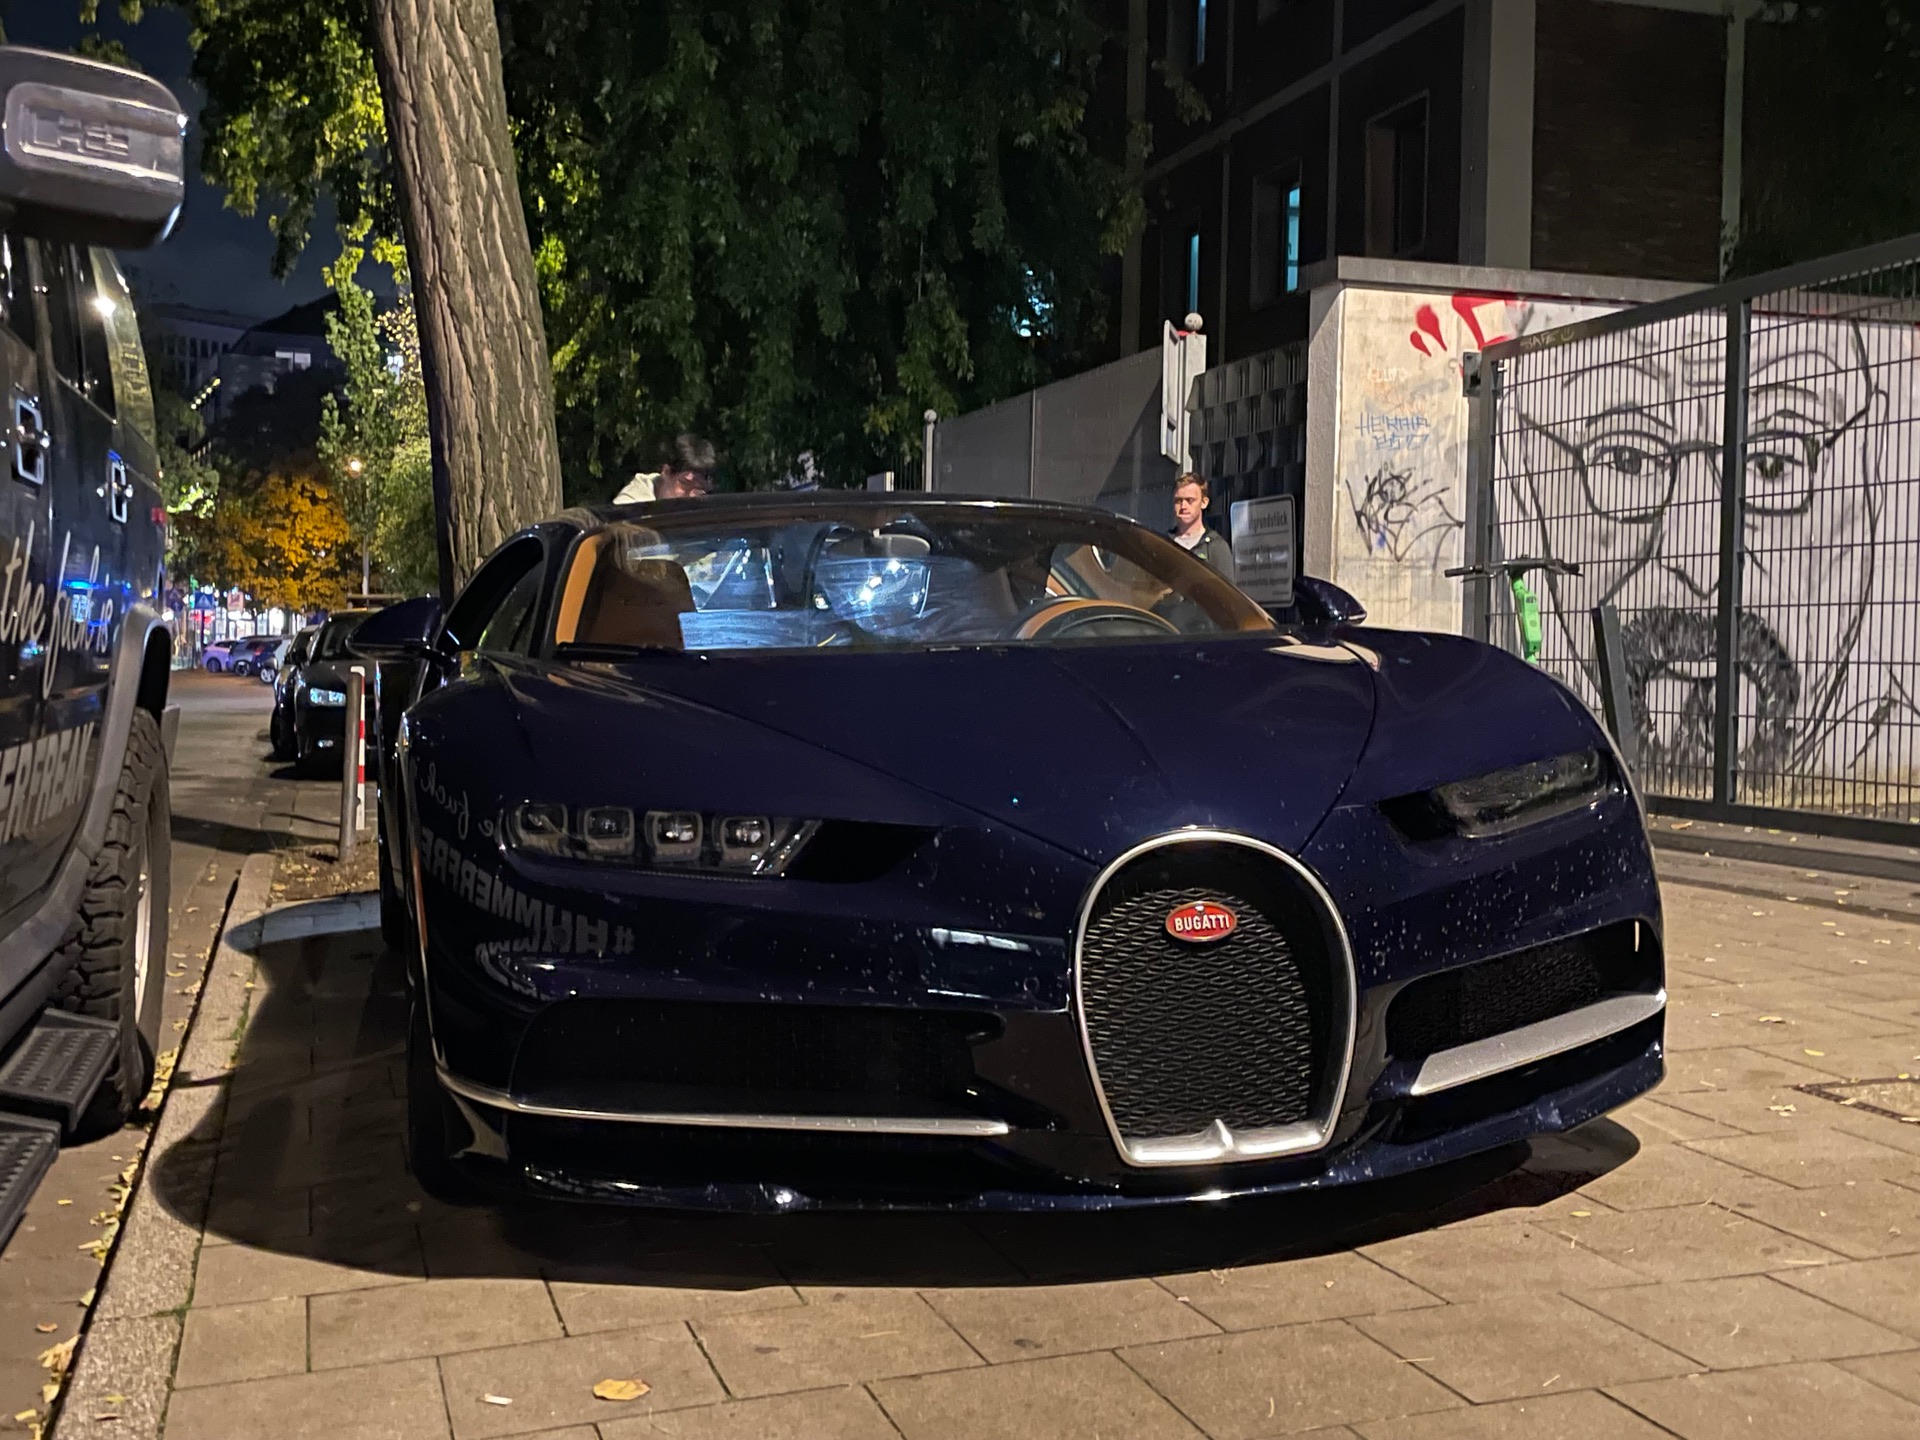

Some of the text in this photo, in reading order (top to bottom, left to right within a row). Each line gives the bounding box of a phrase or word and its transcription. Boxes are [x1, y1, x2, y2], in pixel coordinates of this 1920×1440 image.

[0, 519, 46, 645] the
[42, 529, 100, 701] fuck
[1174, 913, 1230, 932] BUGATTI
